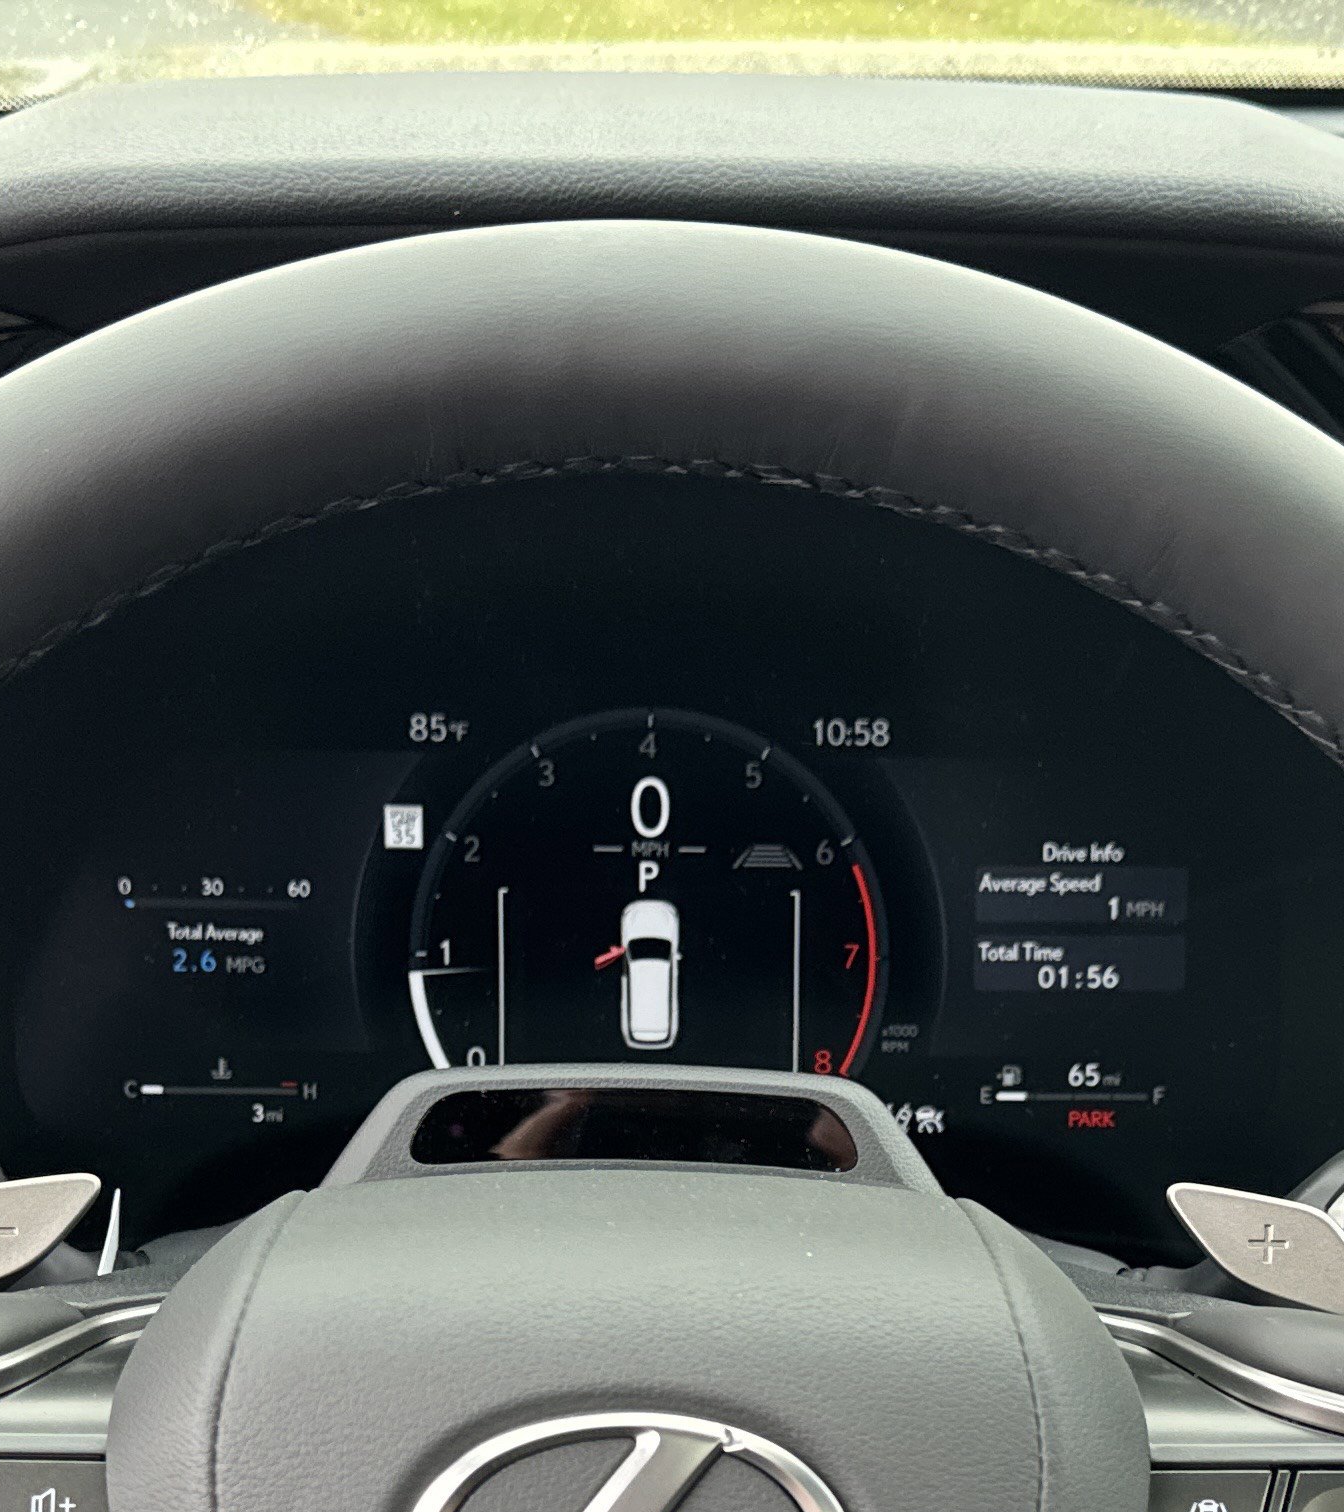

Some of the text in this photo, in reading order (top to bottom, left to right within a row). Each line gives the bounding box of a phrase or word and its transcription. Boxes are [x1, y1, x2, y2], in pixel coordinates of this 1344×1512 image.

[813, 718, 890, 748] 10:58
[638, 733, 656, 758] 4
[538, 763, 555, 787] 3
[744, 763, 762, 788] 5
[630, 776, 670, 838] 0
[464, 838, 481, 863] 2
[631, 841, 670, 859] MPH
[816, 841, 833, 865] 6
[1043, 843, 1124, 864] Drive Info
[118, 877, 132, 896] 0
[201, 878, 224, 897] 30
[638, 861, 659, 892] P
[978, 874, 1102, 897] Average Speed
[288, 880, 311, 898] 60
[1107, 897, 1164, 920] 1 MPH
[167, 922, 263, 944] Total Average
[171, 949, 265, 974] 2.6 MPG
[439, 940, 452, 966] 1
[844, 945, 859, 970] 7
[978, 943, 1063, 963] Total Time
[1038, 965, 1120, 989] 01:56
[813, 1050, 832, 1075] 8
[1067, 1064, 1101, 1088] 65
[124, 1081, 137, 1098] C
[303, 1083, 317, 1100] H
[979, 1087, 993, 1104] E
[1153, 1087, 1165, 1104] F
[252, 1103, 265, 1123] 3
[1067, 1110, 1115, 1128] PARK
